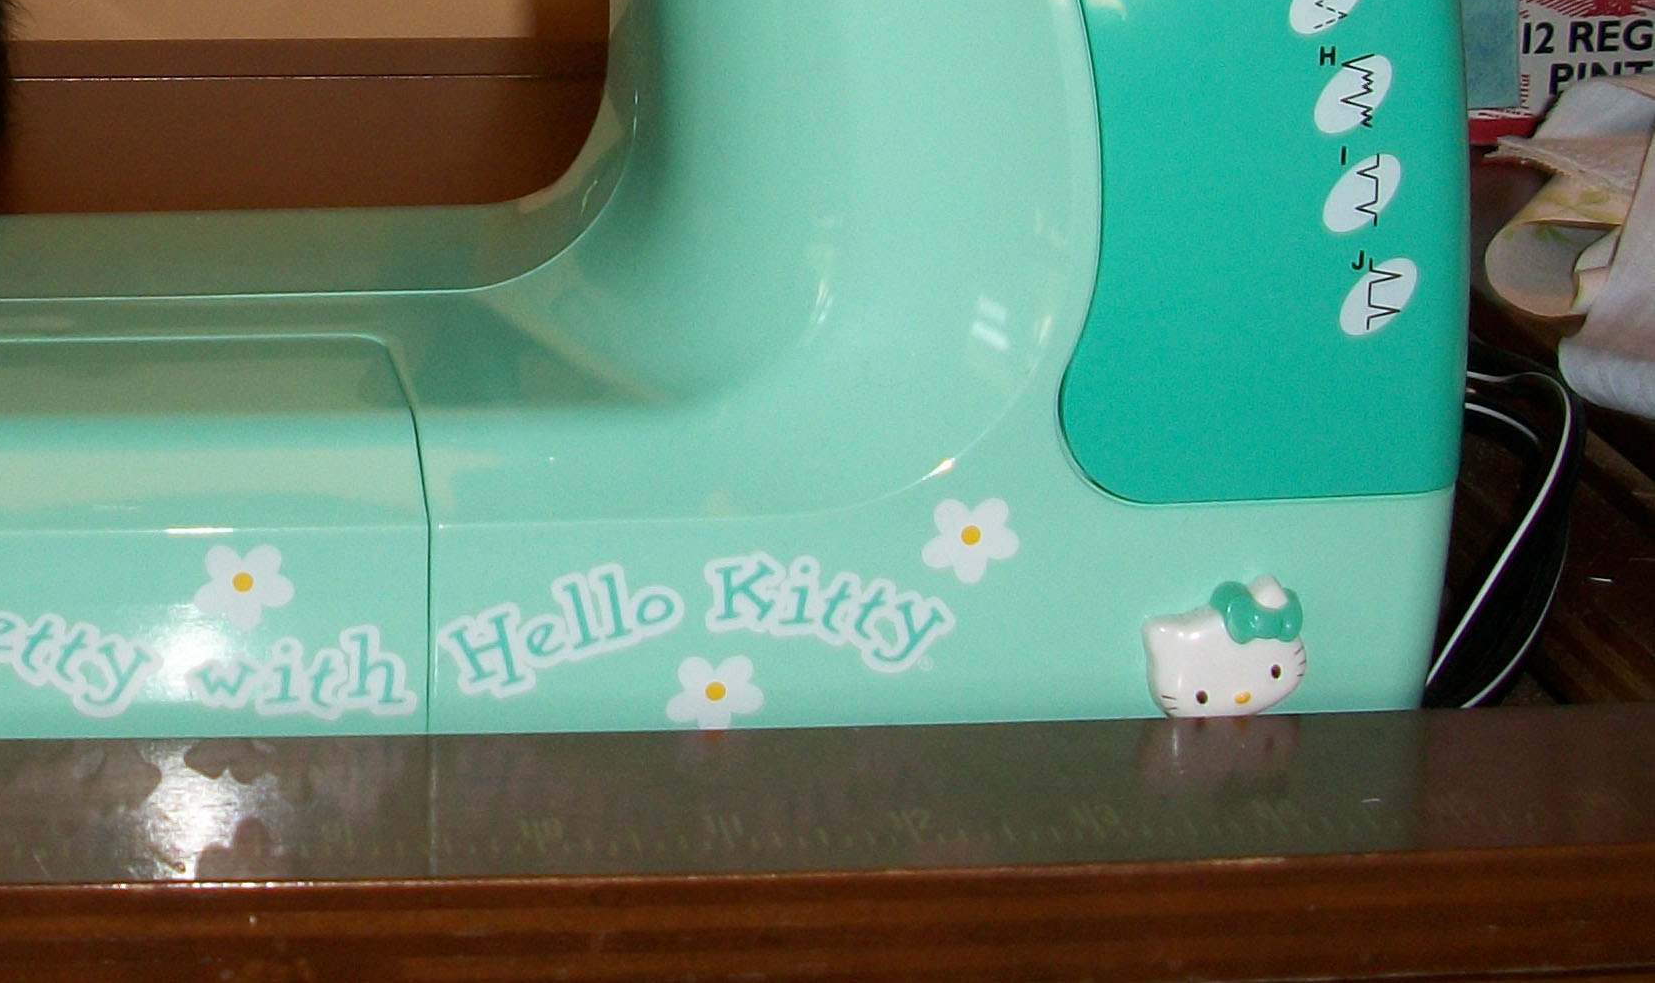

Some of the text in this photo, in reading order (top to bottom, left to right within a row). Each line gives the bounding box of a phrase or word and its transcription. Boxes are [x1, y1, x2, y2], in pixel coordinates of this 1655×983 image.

[1319, 46, 1336, 67] H
[1340, 146, 1346, 166] I
[1351, 250, 1365, 271] J
[194, 632, 411, 707] with
[446, 572, 676, 687] Hello
[715, 563, 946, 664] Kitty
